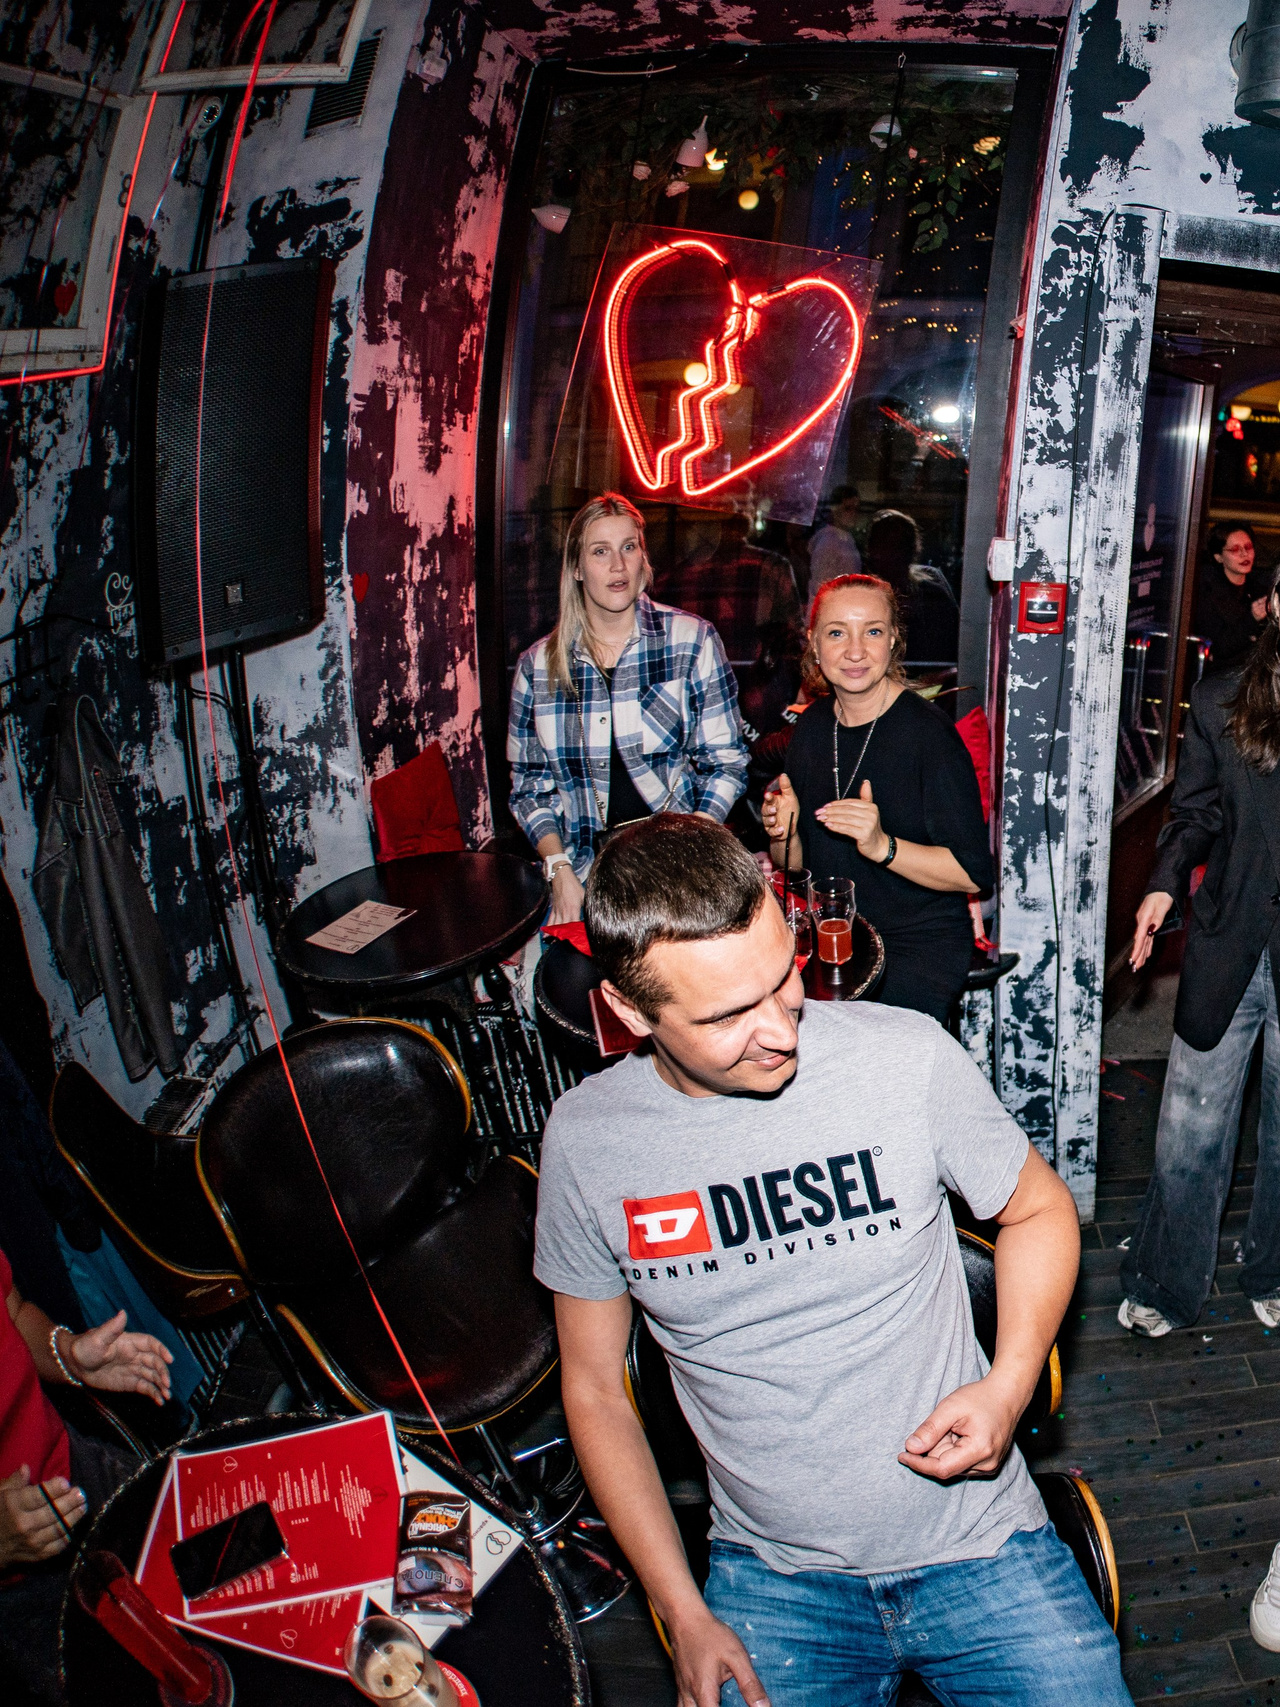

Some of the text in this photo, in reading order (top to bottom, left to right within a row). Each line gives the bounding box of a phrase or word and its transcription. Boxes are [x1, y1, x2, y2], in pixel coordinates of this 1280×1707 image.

[707, 1148, 897, 1249] DIESEL
[632, 1216, 902, 1280] DENIM DIVISION
[410, 1522, 448, 1532] ORIGINAL
[401, 1568, 464, 1589] СЛЕПОТА
